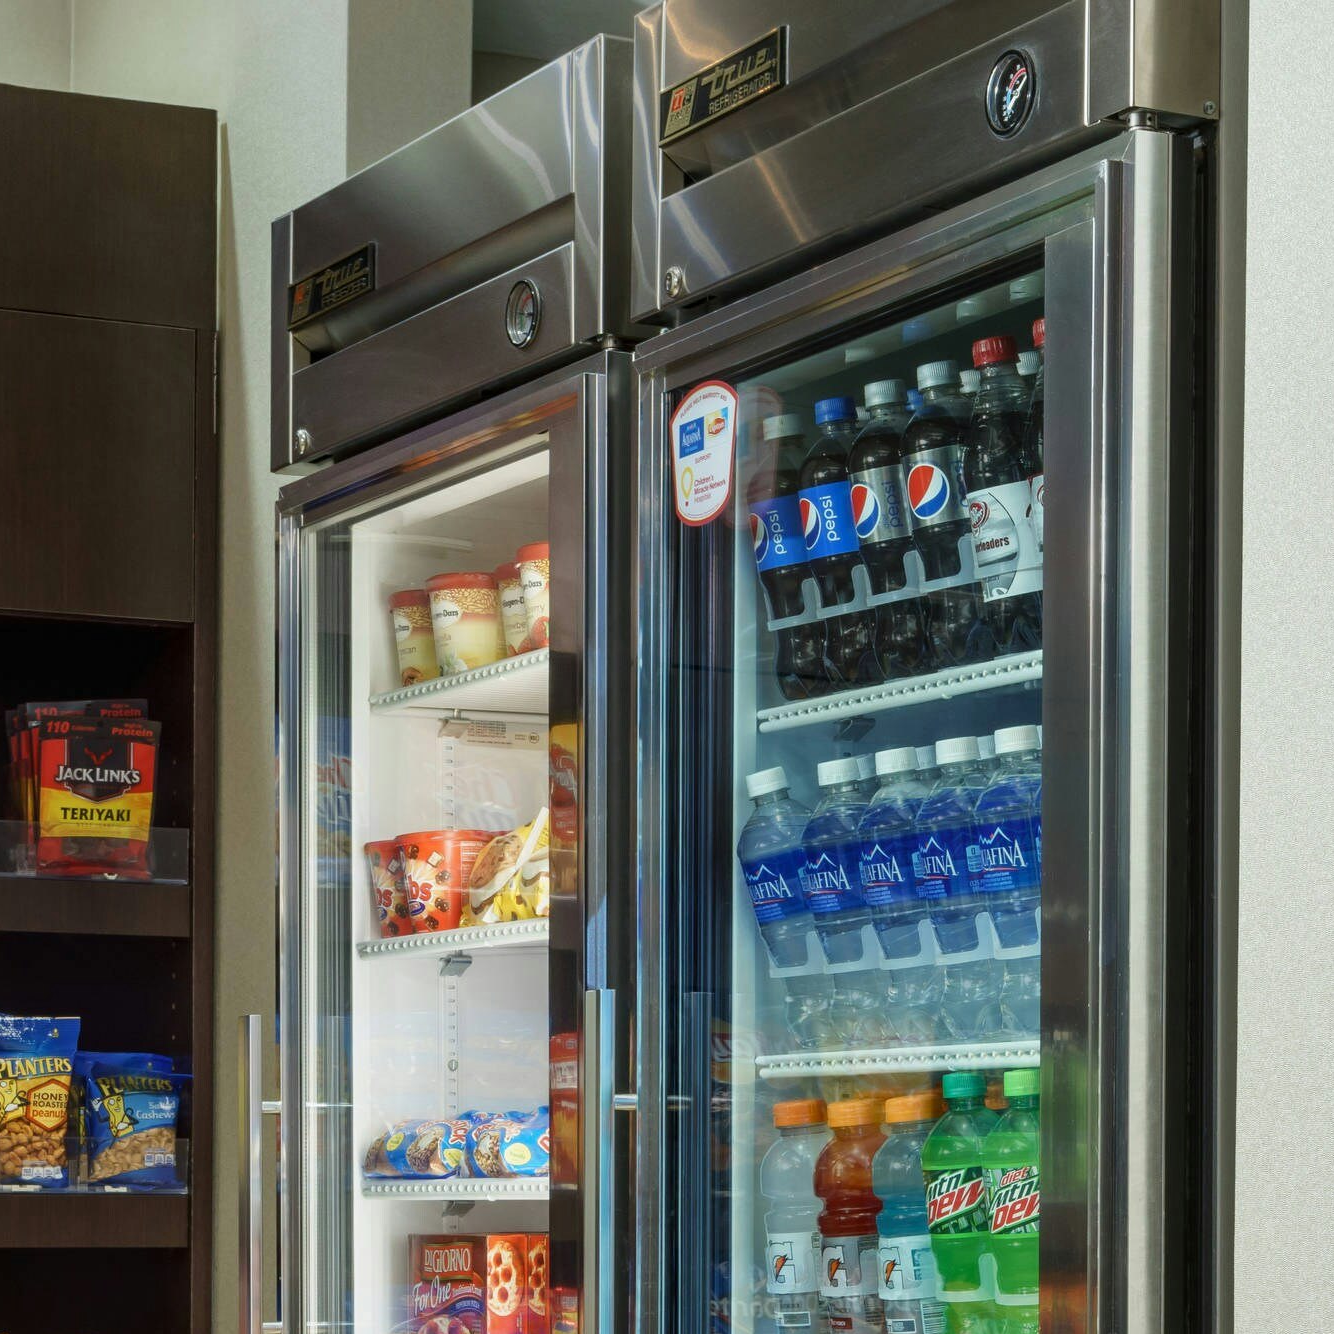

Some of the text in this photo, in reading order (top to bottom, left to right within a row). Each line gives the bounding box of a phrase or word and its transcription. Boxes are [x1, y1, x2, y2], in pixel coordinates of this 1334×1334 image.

[888, 480, 904, 528] pepsi
[826, 494, 841, 543] pepsi
[774, 509, 788, 556] pepsi
[111, 727, 154, 738] Protein
[56, 766, 140, 783] JACK LINK'S
[61, 807, 131, 822] TERIYAKI
[33, 1090, 68, 1101] HONEY
[1001, 1167, 1028, 1187] diet
